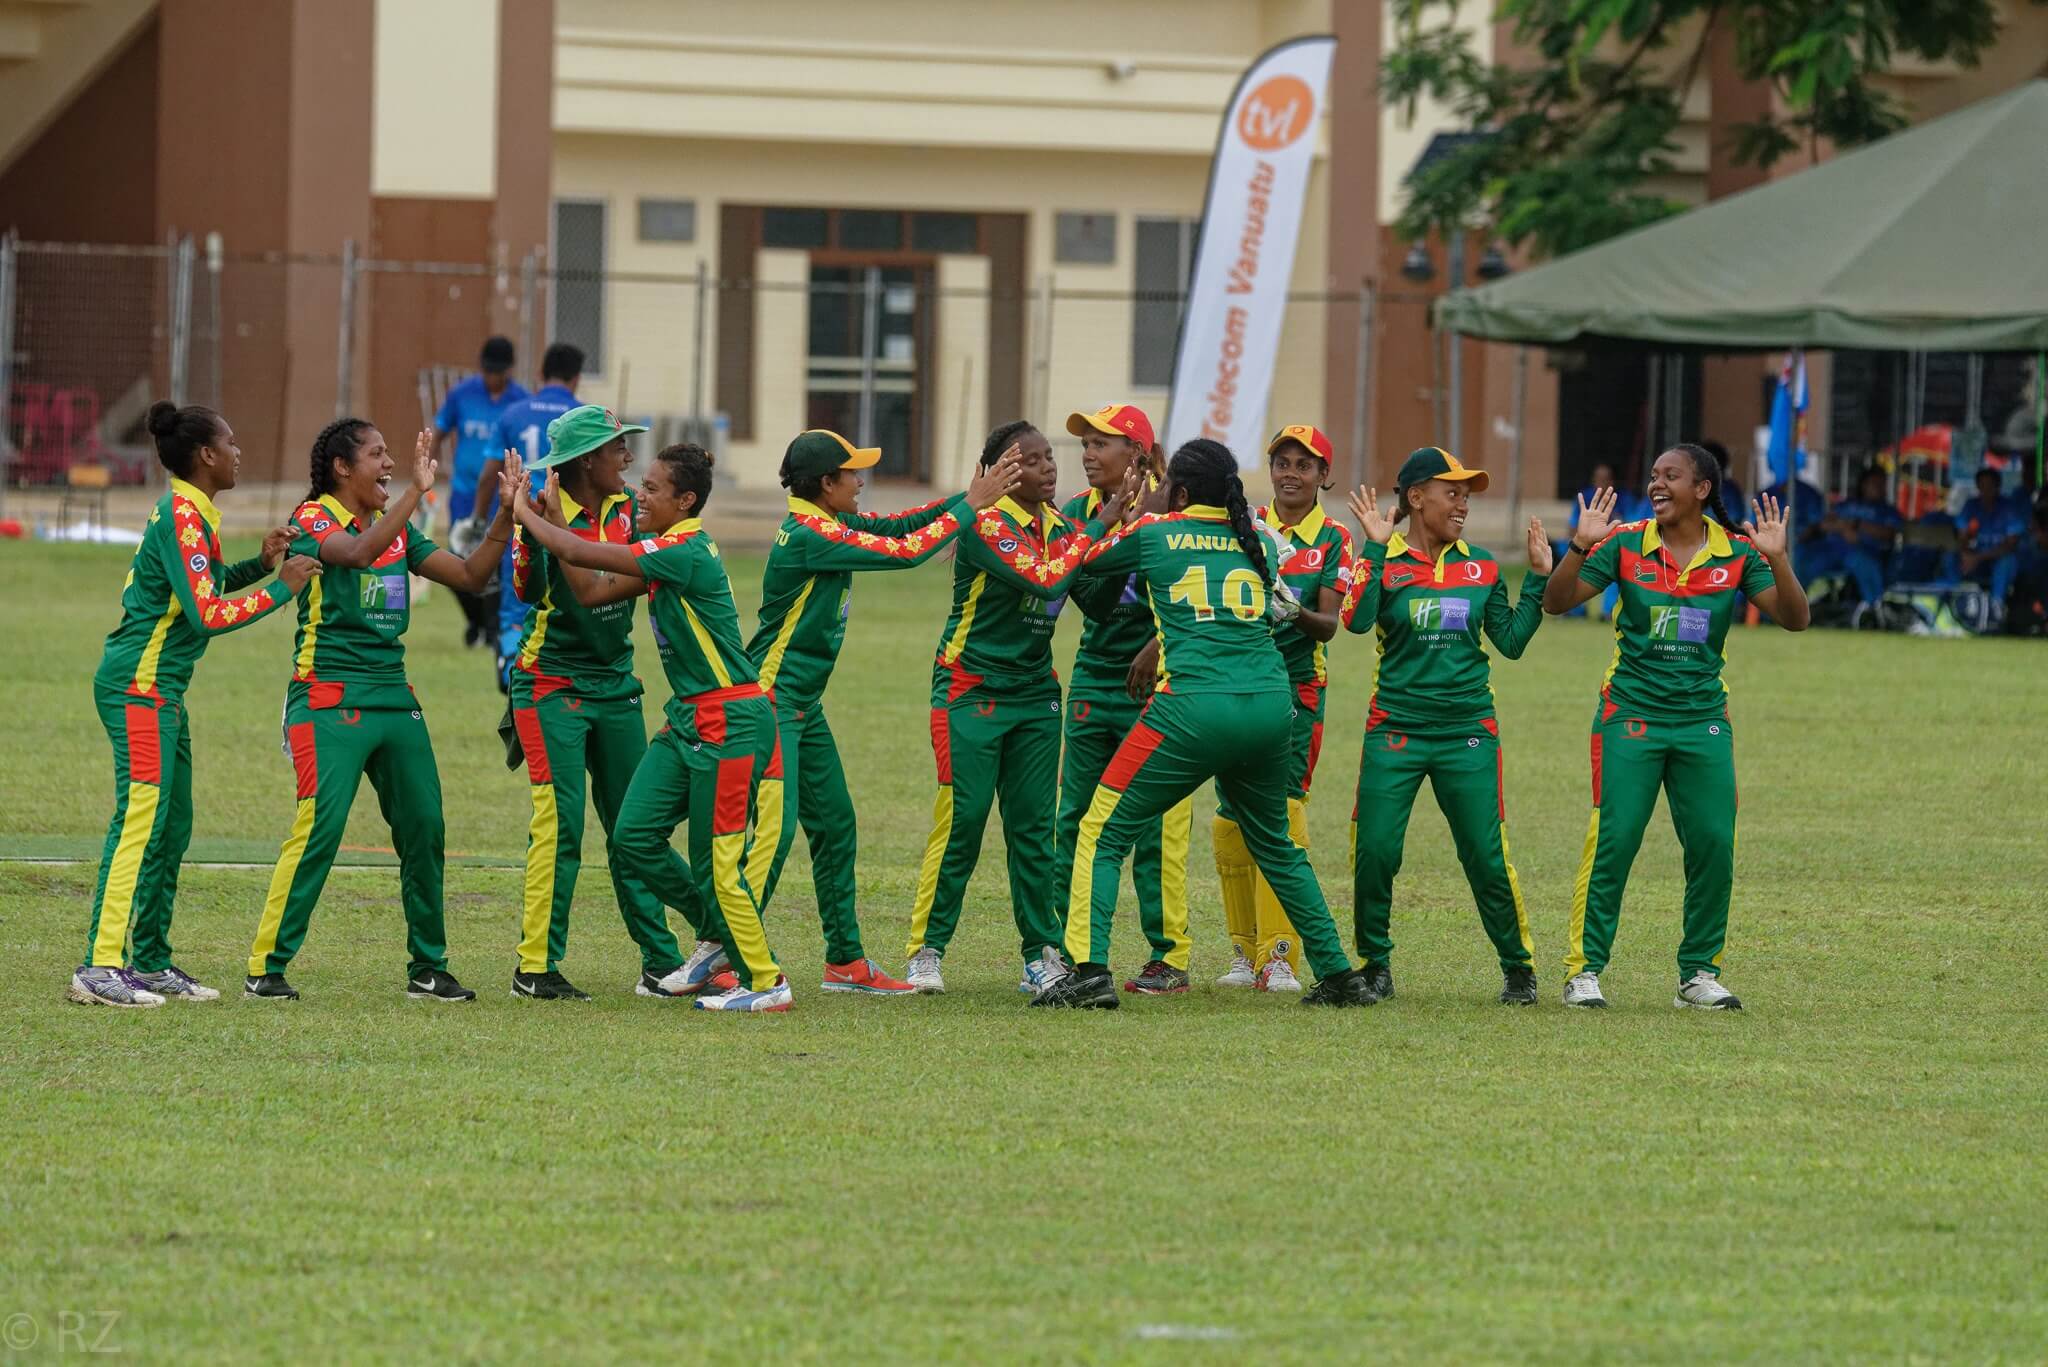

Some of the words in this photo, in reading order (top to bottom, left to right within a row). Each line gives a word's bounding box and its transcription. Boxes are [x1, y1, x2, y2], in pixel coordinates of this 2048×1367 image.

[1202, 306, 1248, 441] Telecom
[1225, 160, 1276, 295] Vanuatu
[1169, 565, 1266, 622] 10
[1682, 620, 1705, 631] Resort
[1428, 633, 1440, 641] IHG
[1441, 633, 1462, 641] HOTEL
[1678, 645, 1700, 654] HOTEL
